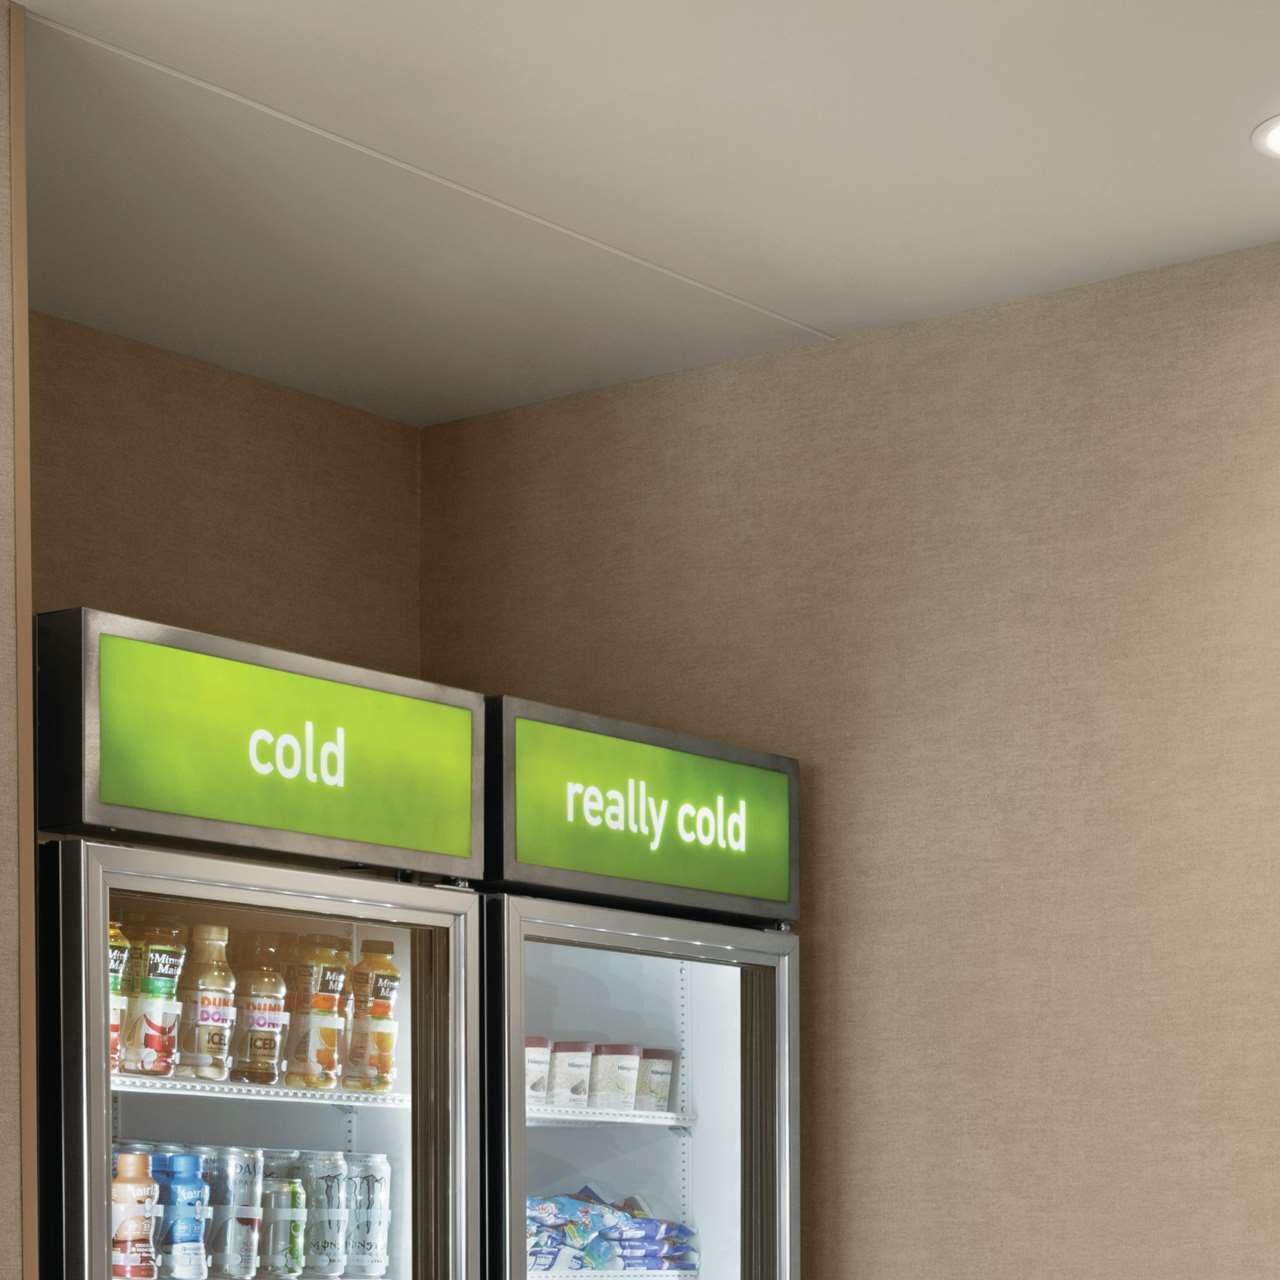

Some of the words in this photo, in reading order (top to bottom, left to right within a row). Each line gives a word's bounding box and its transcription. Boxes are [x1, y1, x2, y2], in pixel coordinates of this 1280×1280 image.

[248, 721, 345, 788] cold
[566, 779, 667, 851] really
[676, 796, 747, 853] cold
